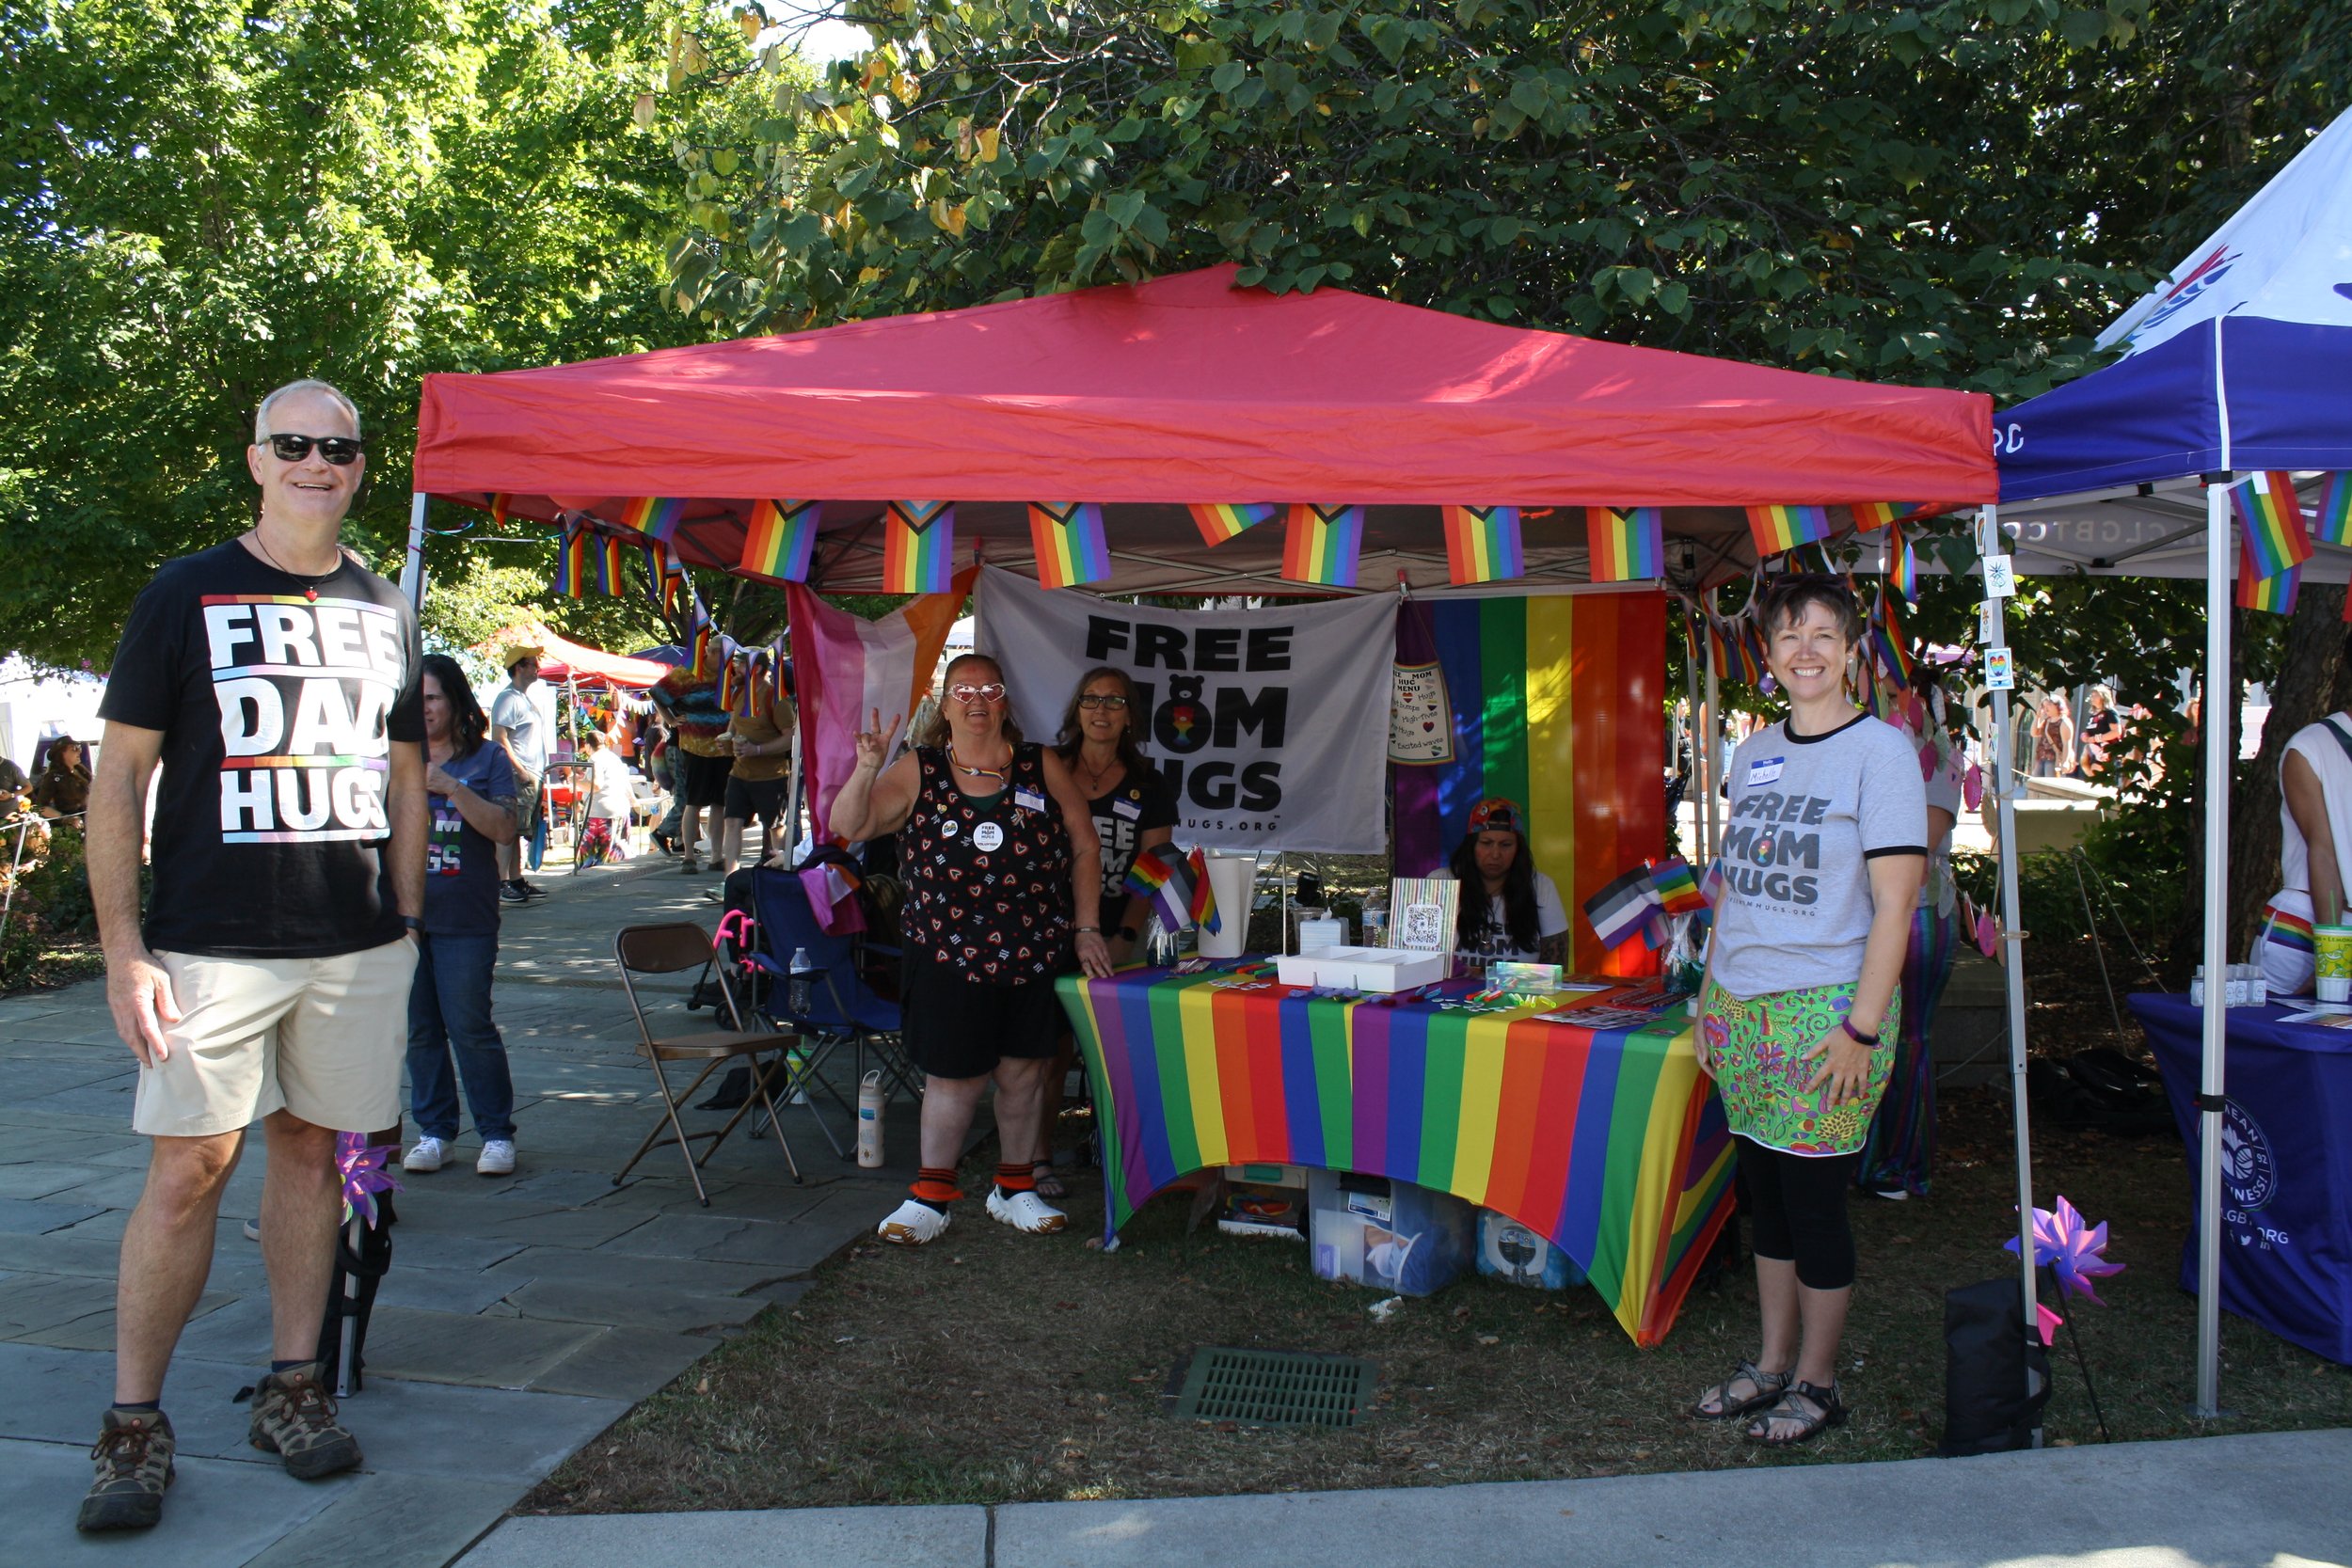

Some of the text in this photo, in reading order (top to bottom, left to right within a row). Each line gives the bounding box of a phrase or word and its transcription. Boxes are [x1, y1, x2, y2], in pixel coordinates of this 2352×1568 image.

[203, 605, 400, 673] FREE
[1086, 615, 1295, 672] FREE
[1412, 671, 1432, 679] MOM
[1418, 691, 1437, 700] Hugs
[214, 677, 396, 758] DAD
[1147, 757, 1281, 812] UGS
[1751, 768, 1776, 782] Michelle
[220, 767, 388, 831] HUGS
[1733, 791, 1832, 825] FREE
[1721, 823, 1820, 870] MOM
[1724, 865, 1819, 906] HUGS
[2257, 1153, 2268, 1164] 92
